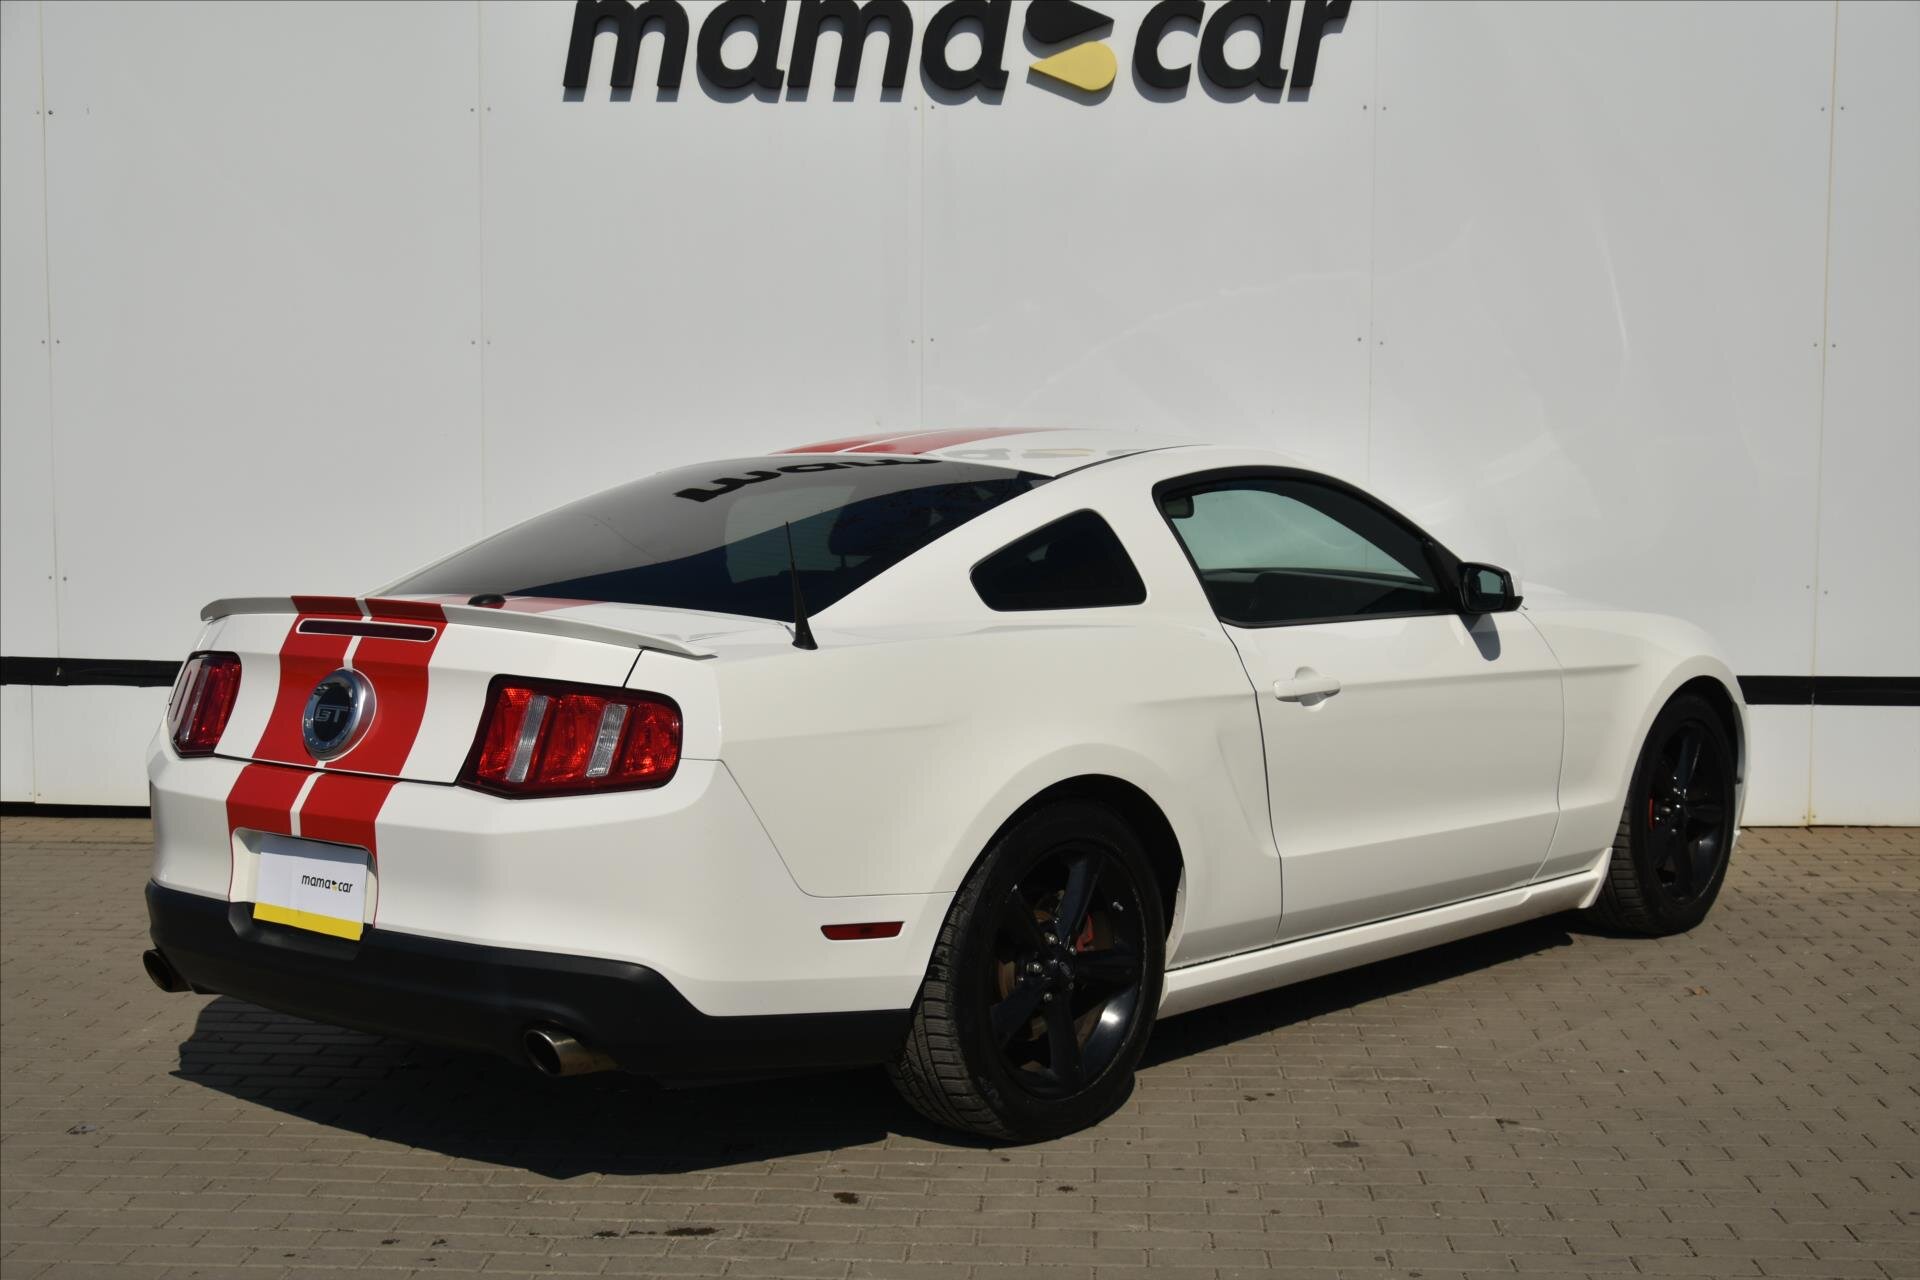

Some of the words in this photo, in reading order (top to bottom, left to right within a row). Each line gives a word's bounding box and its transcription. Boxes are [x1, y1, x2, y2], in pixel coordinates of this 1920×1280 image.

[563, 0, 1009, 91] mama
[1134, 0, 1352, 90] car
[315, 704, 346, 723] GT
[301, 874, 331, 890] mama
[338, 881, 354, 893] car
